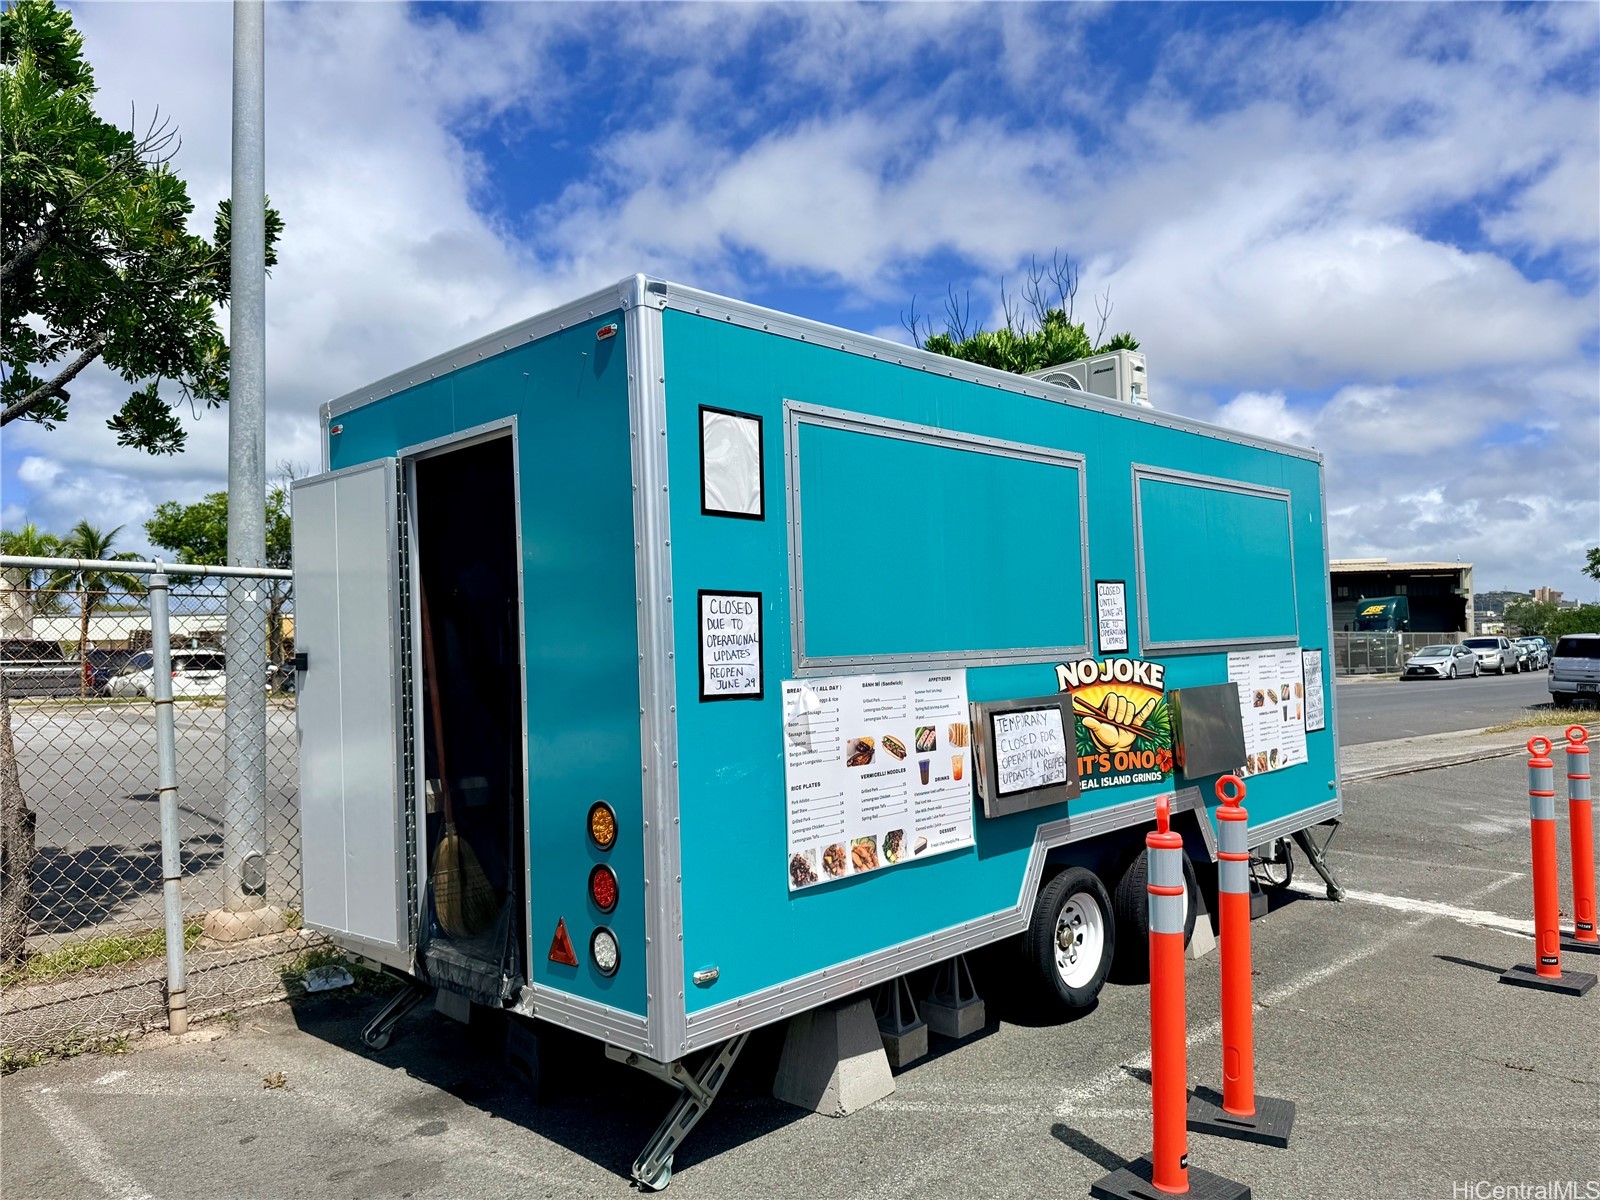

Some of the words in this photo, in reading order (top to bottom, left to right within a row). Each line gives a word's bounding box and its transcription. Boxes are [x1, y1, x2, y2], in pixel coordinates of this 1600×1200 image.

[1099, 585, 1121, 597] CLOSED
[710, 599, 753, 615] CLOSED
[1100, 598, 1117, 607] UNTIL
[1100, 608, 1115, 618] JUNE
[1116, 606, 1123, 616] 29
[707, 618, 725, 631] DUE
[731, 618, 744, 630] TO
[1100, 621, 1111, 629] DUE
[707, 633, 759, 648] OPERATIONAL
[713, 649, 751, 662] UPDATES
[710, 667, 744, 680] REOPEN
[1055, 658, 1099, 692] NO
[1099, 658, 1165, 690] JOKE
[715, 679, 740, 691] JUNE
[744, 678, 756, 688] 29
[1000, 732, 1037, 753] CLOSED
[1040, 729, 1057, 743] FOR
[1001, 747, 1055, 769] OPERATIONAL
[1077, 753, 1111, 777] IT'S
[1114, 750, 1155, 771] ONO
[1040, 773, 1054, 784] JUNE
[1054, 769, 1065, 779] 29
[1101, 774, 1131, 787] ISLAND
[1132, 771, 1162, 784] GRINDS
